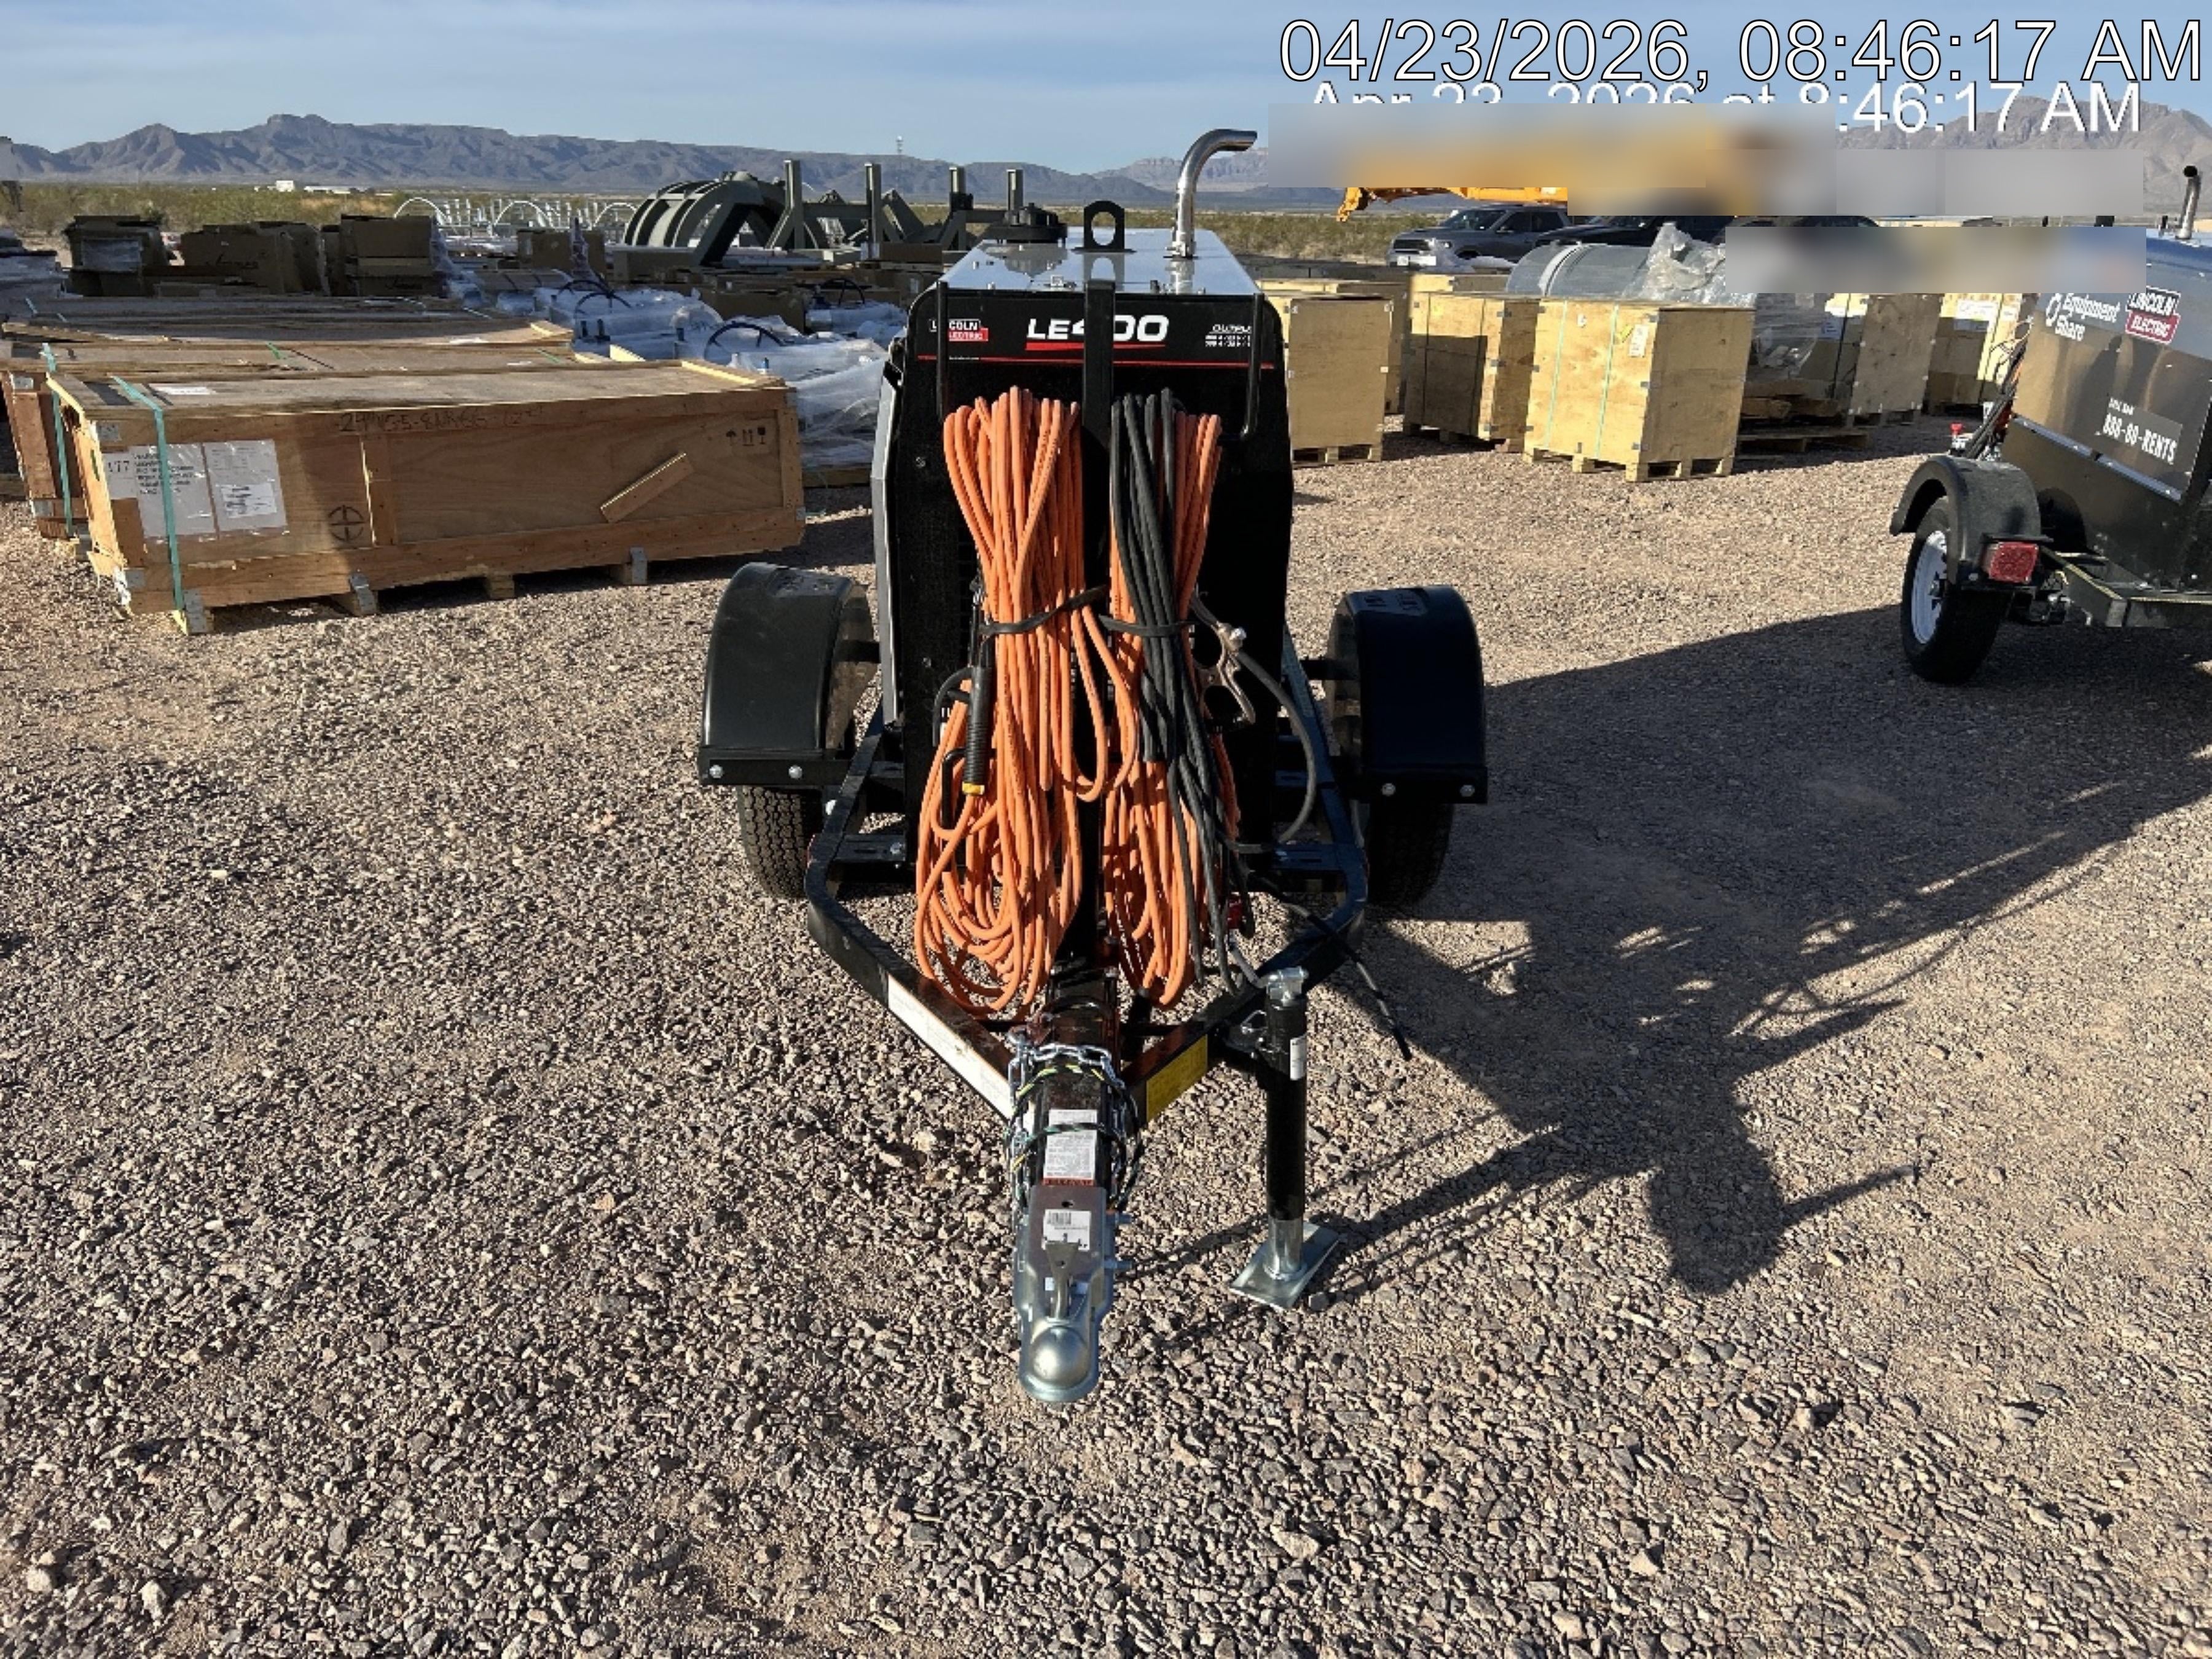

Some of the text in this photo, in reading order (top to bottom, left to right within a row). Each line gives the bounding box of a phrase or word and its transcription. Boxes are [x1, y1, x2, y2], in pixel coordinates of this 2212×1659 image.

[2063, 293, 2120, 323] Equipment
[931, 320, 978, 331] LCOLN
[1212, 324, 1252, 332] OUTPU
[2055, 315, 2085, 341] Share
